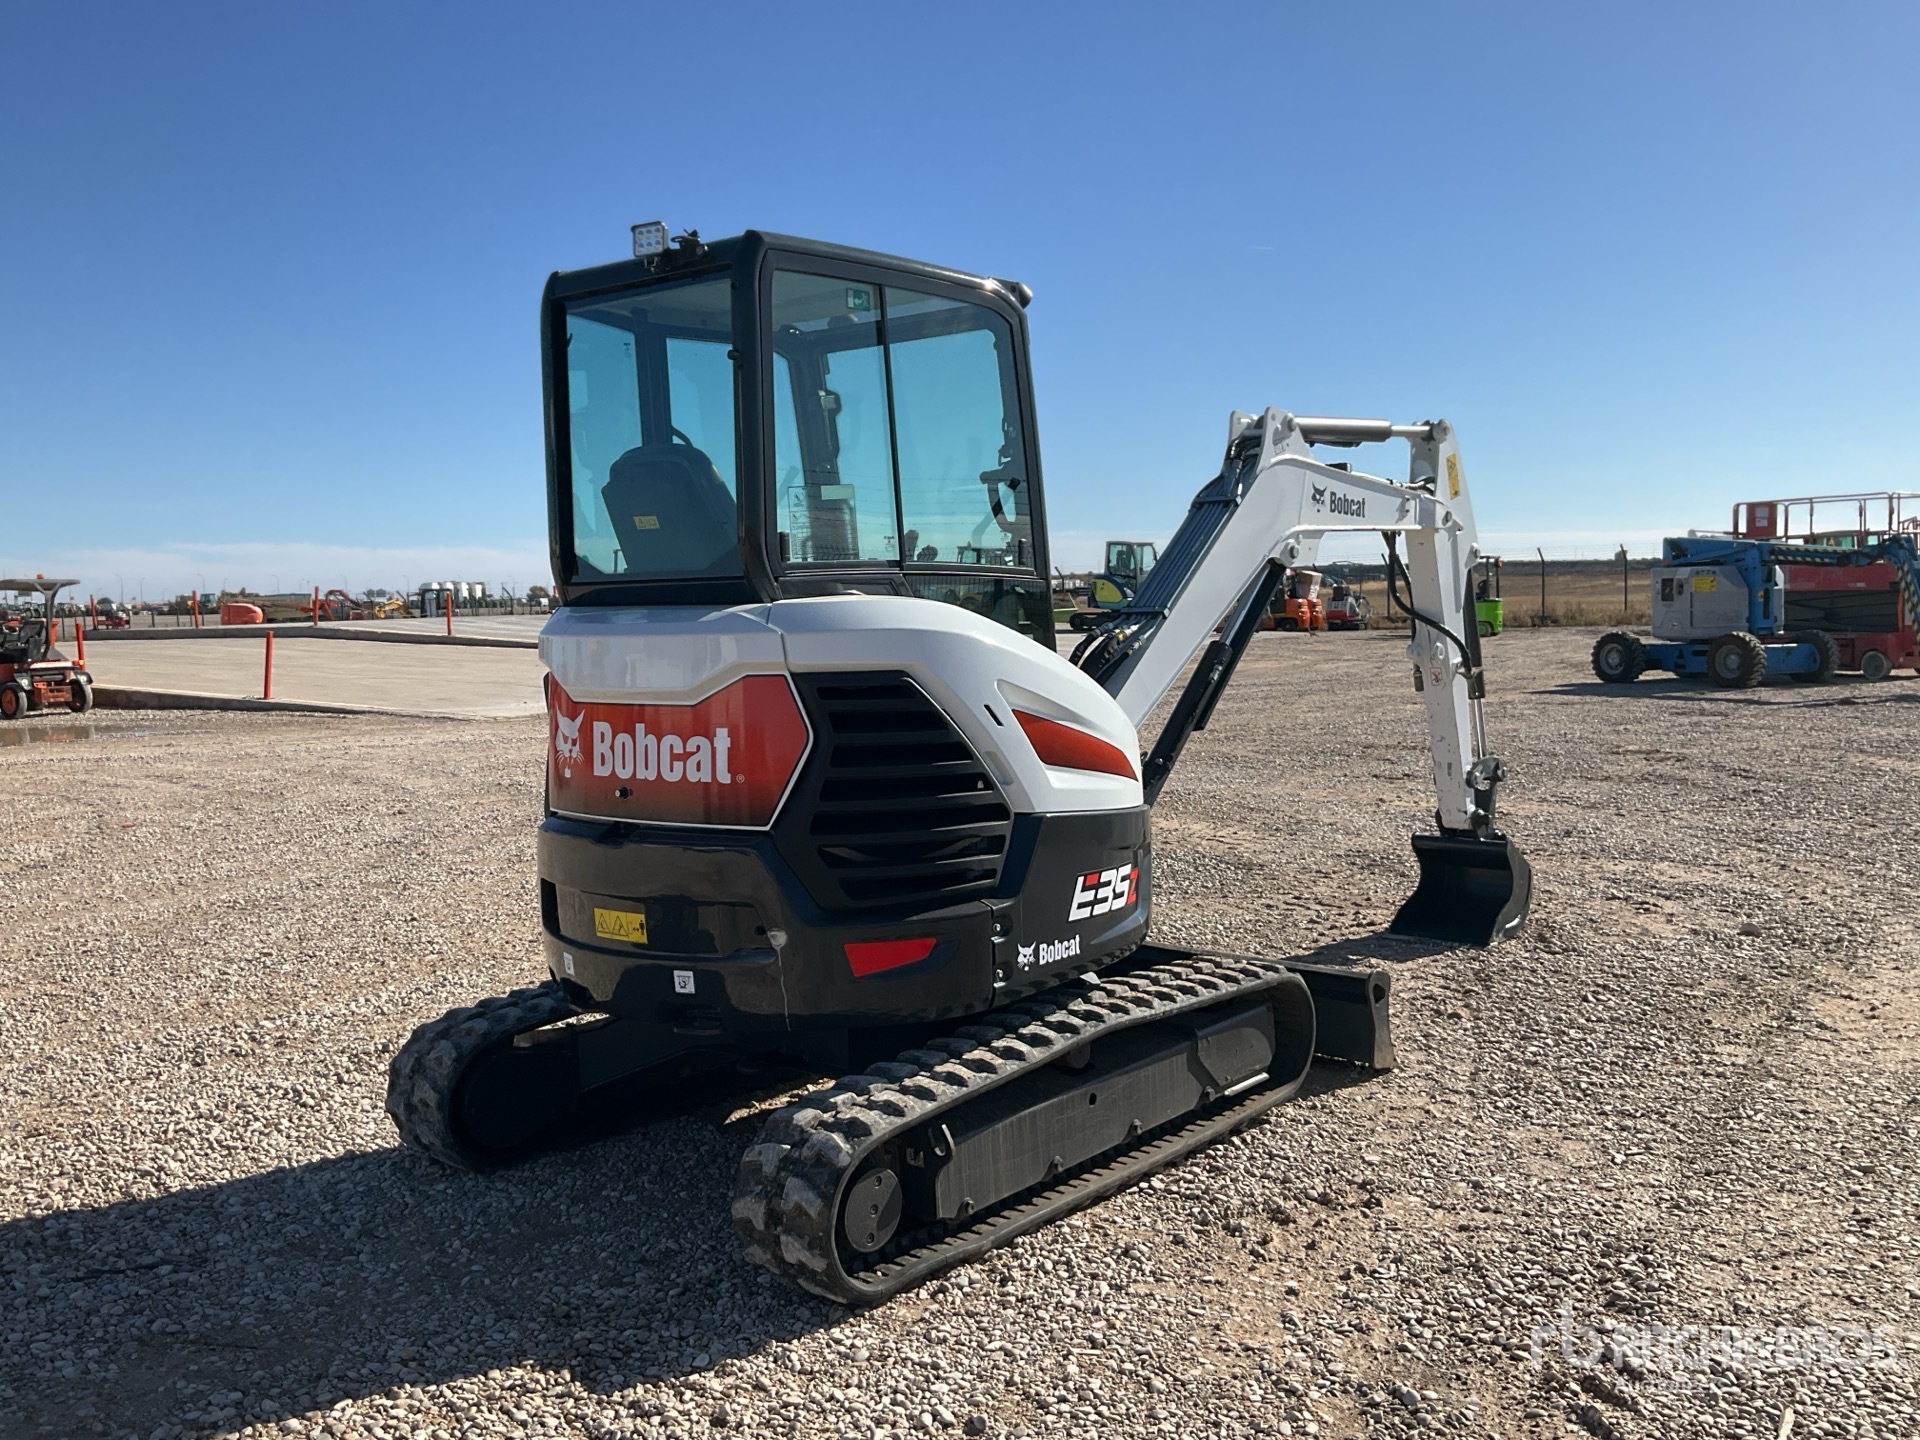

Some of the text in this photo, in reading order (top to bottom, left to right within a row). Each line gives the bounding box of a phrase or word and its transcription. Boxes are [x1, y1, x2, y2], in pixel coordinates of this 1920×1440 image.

[1330, 491, 1365, 518] Bobcat
[593, 721, 731, 784] Bobcat
[1039, 934, 1080, 965] Bobcat
